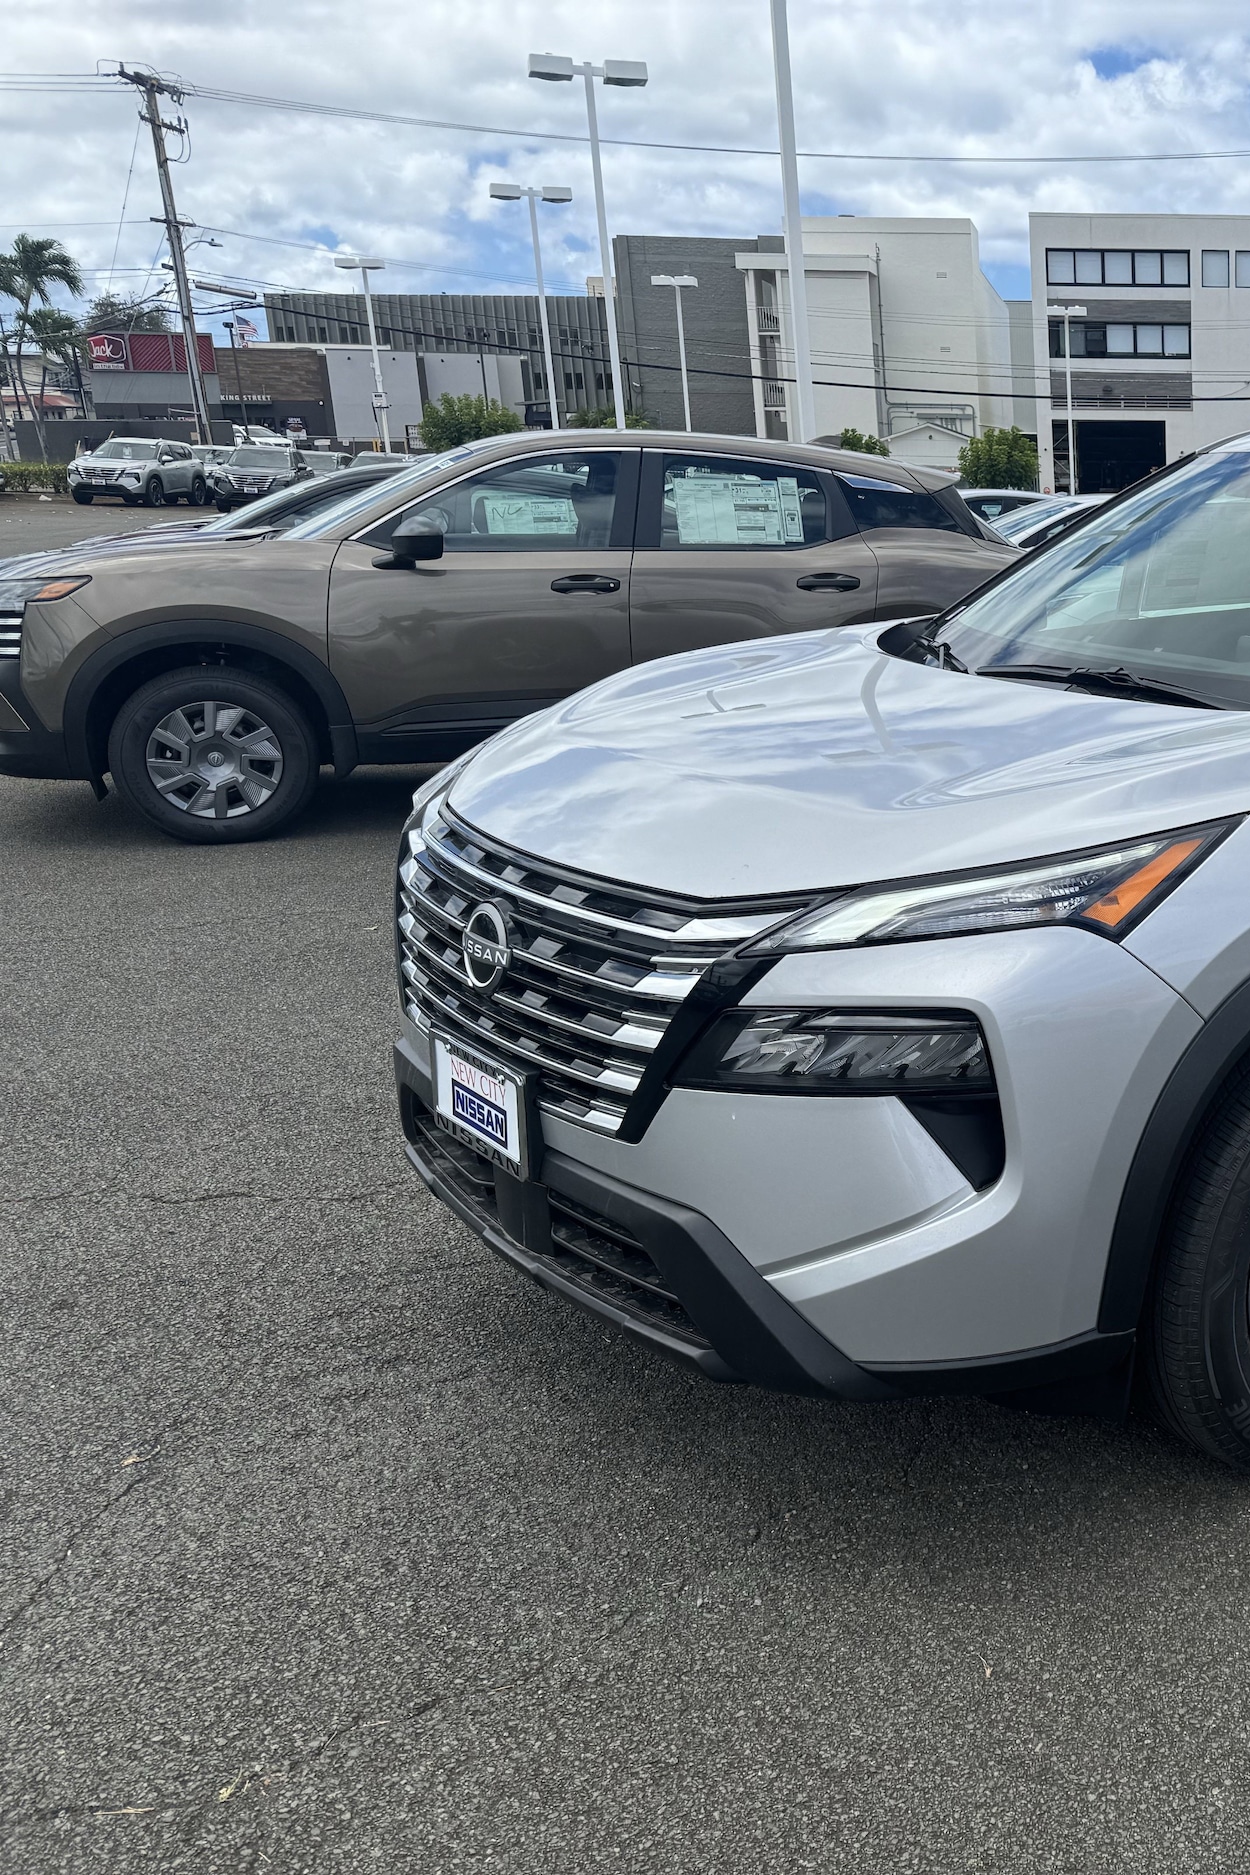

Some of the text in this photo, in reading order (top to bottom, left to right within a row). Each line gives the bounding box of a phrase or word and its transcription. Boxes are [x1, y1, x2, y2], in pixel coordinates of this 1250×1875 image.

[90, 339, 122, 358] Jack
[463, 937, 507, 966] ISSAN
[451, 1057, 507, 1107] NEW CITY
[455, 1089, 504, 1138] NISSAN
[436, 1114, 521, 1177] NISSAN
